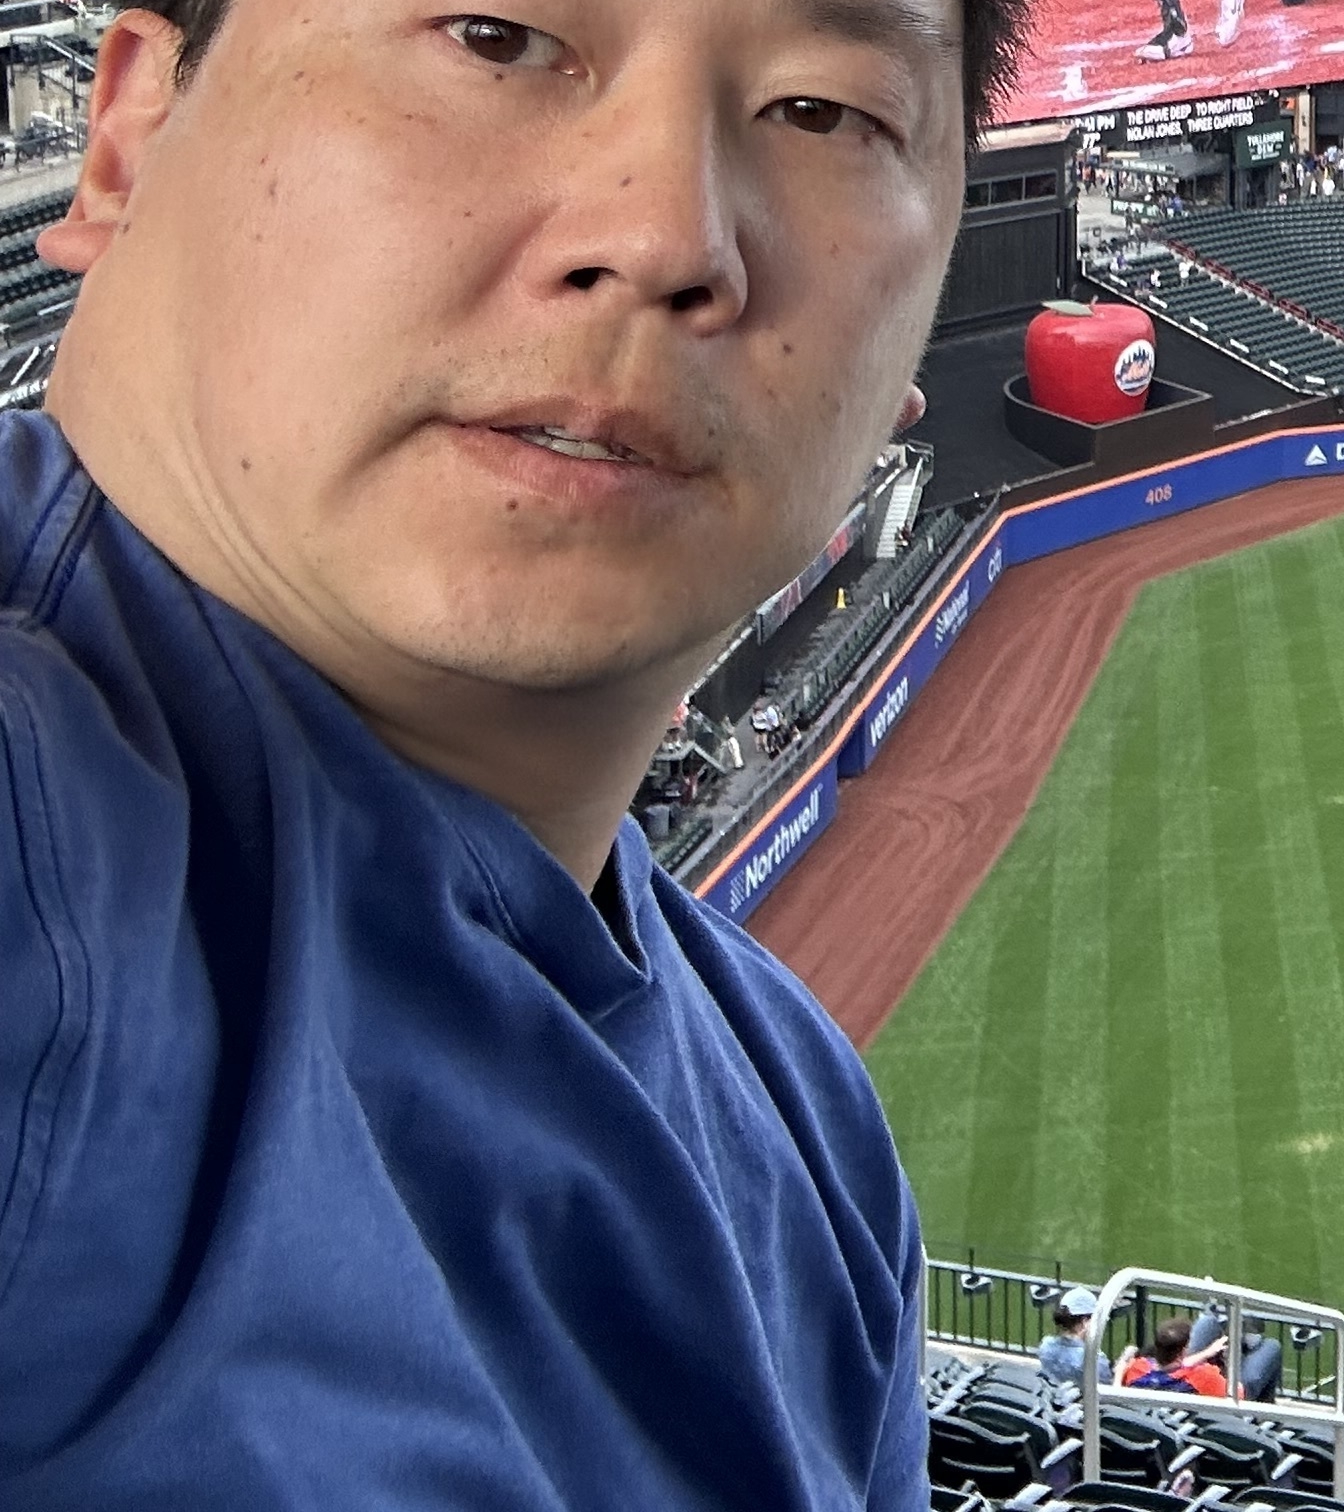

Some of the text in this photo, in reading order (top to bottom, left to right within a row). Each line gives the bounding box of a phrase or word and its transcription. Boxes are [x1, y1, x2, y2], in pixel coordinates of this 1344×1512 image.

[1169, 104, 1192, 121] DEEP
[1196, 102, 1208, 117] TO
[1126, 124, 1155, 142] NOLAN
[1187, 116, 1214, 133] THREE
[1213, 111, 1254, 131] QUARTERS
[1144, 484, 1173, 506] 408
[744, 788, 821, 898] Northwell
